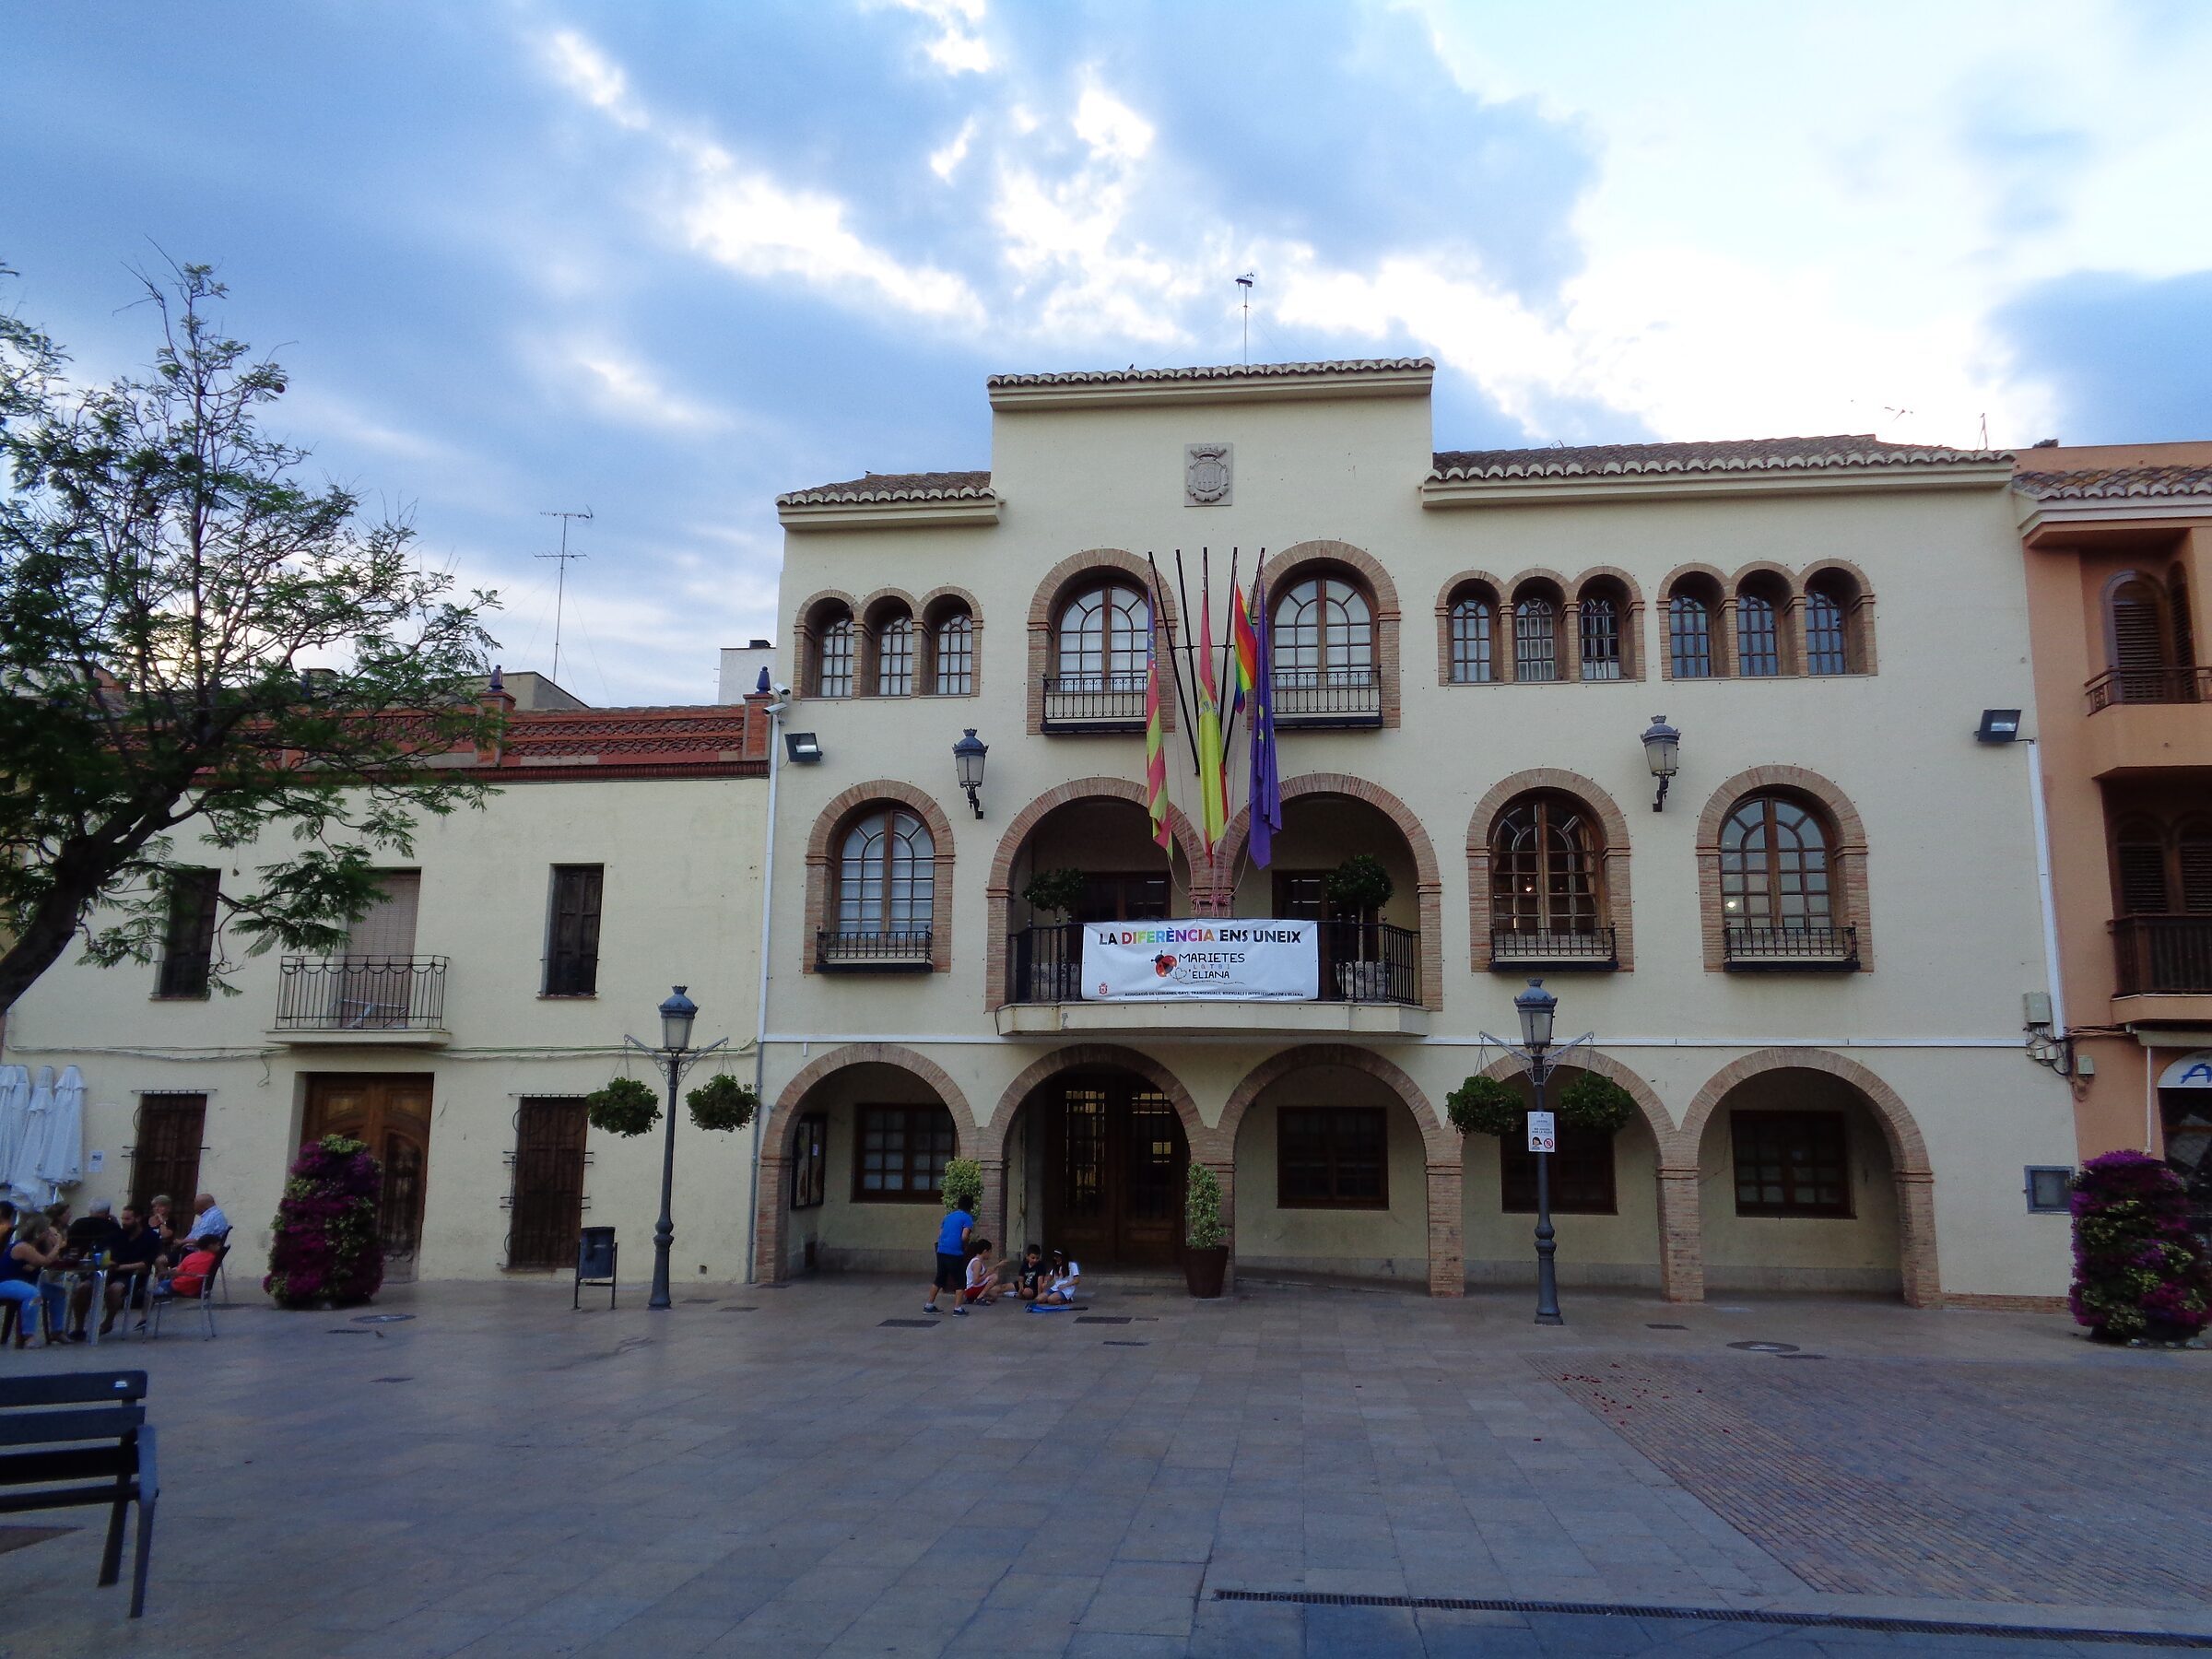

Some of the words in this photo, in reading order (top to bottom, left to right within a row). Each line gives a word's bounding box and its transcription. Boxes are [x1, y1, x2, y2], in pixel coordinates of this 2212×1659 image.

[1099, 932, 1118, 946] LA
[1121, 927, 1215, 945] DIFERÈNCIA
[1219, 929, 1249, 943] ENS
[1253, 930, 1301, 944] UNEIX
[1178, 952, 1245, 963] MARIETES
